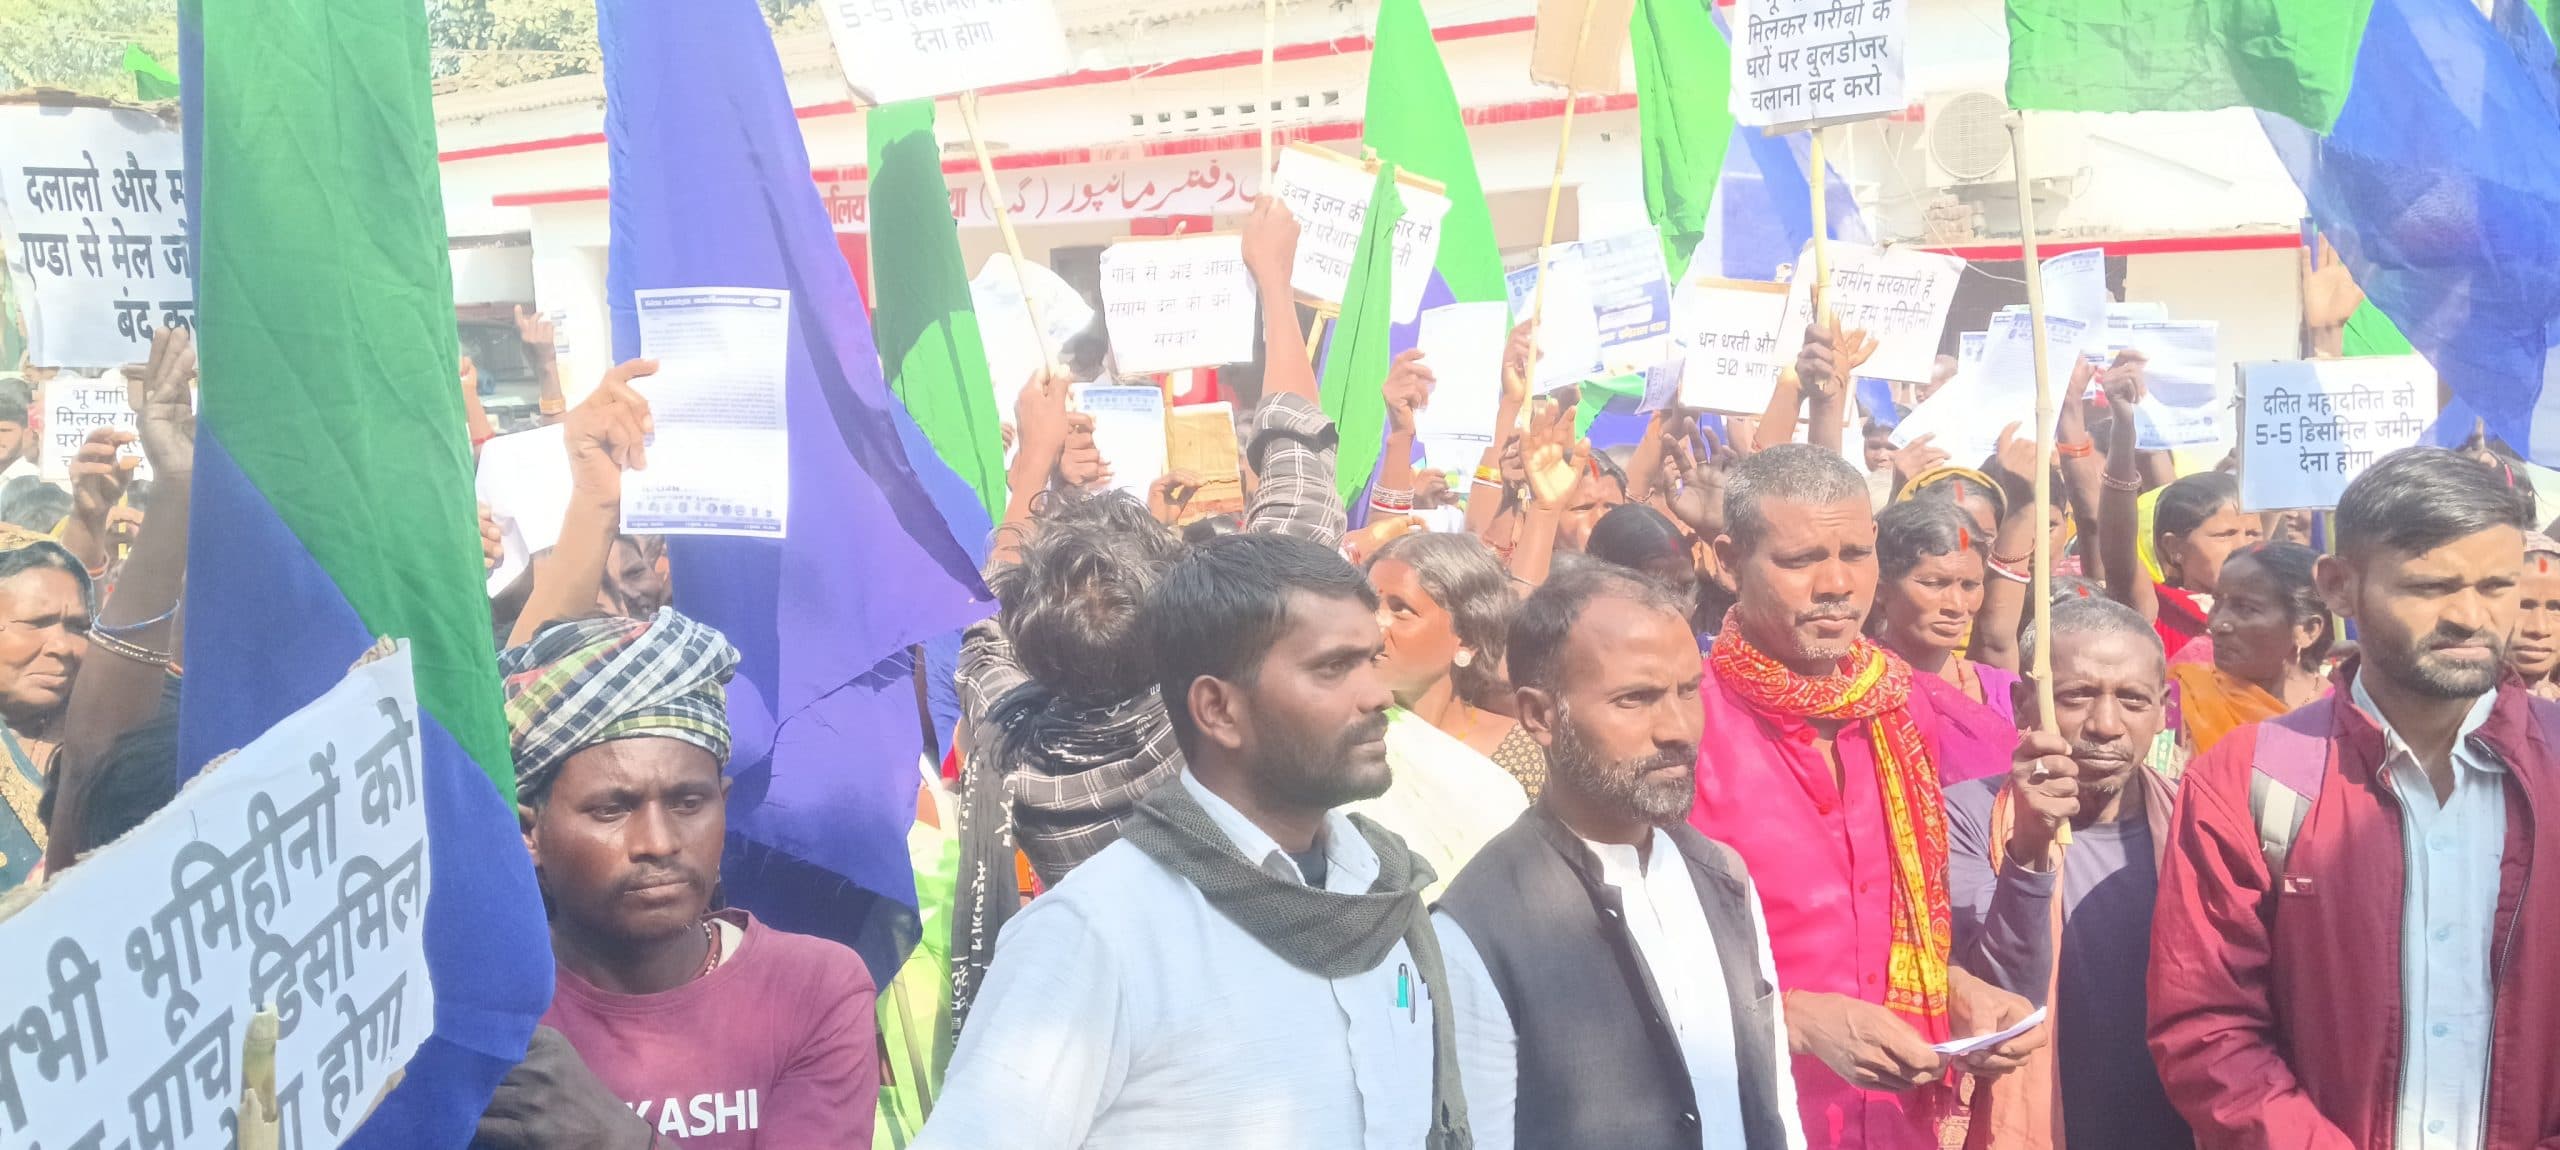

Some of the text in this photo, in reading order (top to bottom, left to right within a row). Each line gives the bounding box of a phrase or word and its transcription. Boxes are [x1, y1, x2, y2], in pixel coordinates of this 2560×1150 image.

[911, 19, 993, 53] देना होगा
[1749, 14, 1807, 45] मिलकर
[1746, 31, 1888, 78] घरों पर बुलडोजर
[1750, 84, 1802, 111] चलाना
[1843, 64, 1882, 98] करो
[22, 150, 103, 213] दलालो
[111, 151, 162, 213] और
[76, 217, 103, 278] से
[108, 217, 154, 278] मेल
[160, 218, 191, 278] जो
[1836, 264, 1874, 293] जमीन
[1877, 270, 1921, 297] सरकारी
[113, 286, 154, 343] बंद
[1699, 332, 1717, 348] धन
[74, 389, 89, 409] भू
[2263, 382, 2415, 415] दलित महादलित को
[56, 407, 116, 426] मिलकर
[2256, 412, 2423, 445] 5-5 डिसमिल जमीन
[2299, 444, 2374, 474] देना होगा
[125, 741, 341, 1046] भूमिहीनों
[354, 696, 416, 828] को
[249, 838, 424, 1040] डिसमिल
[317, 970, 407, 1137] होगा
